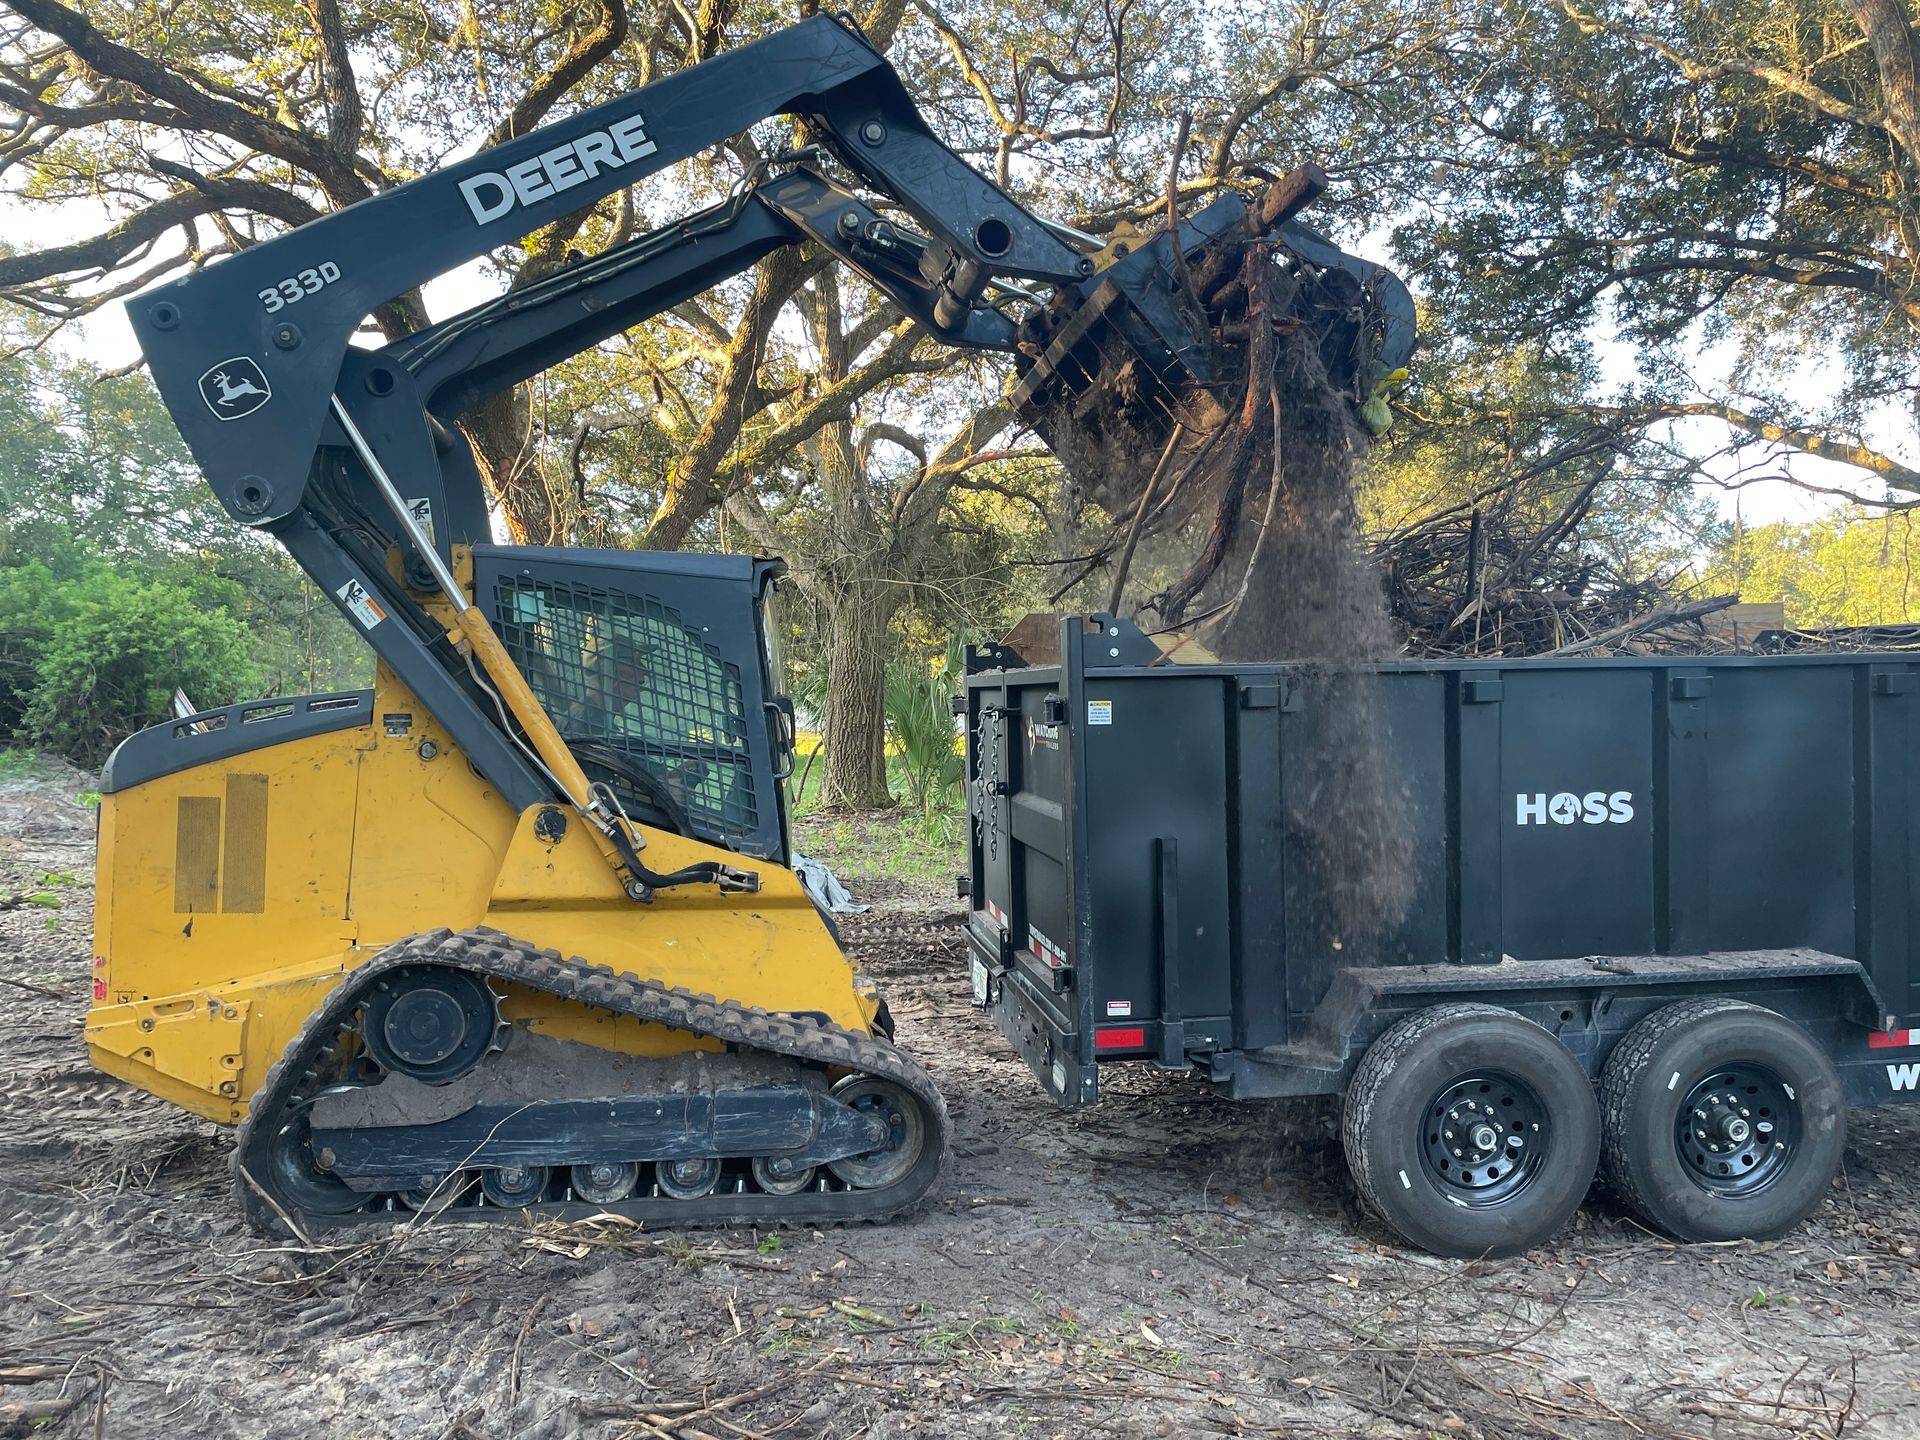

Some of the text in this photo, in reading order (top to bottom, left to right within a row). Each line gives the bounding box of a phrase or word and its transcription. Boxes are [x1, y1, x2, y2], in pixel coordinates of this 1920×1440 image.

[457, 114, 658, 226] DEERE
[257, 261, 342, 314] 333D
[1516, 791, 1634, 825] HOSS
